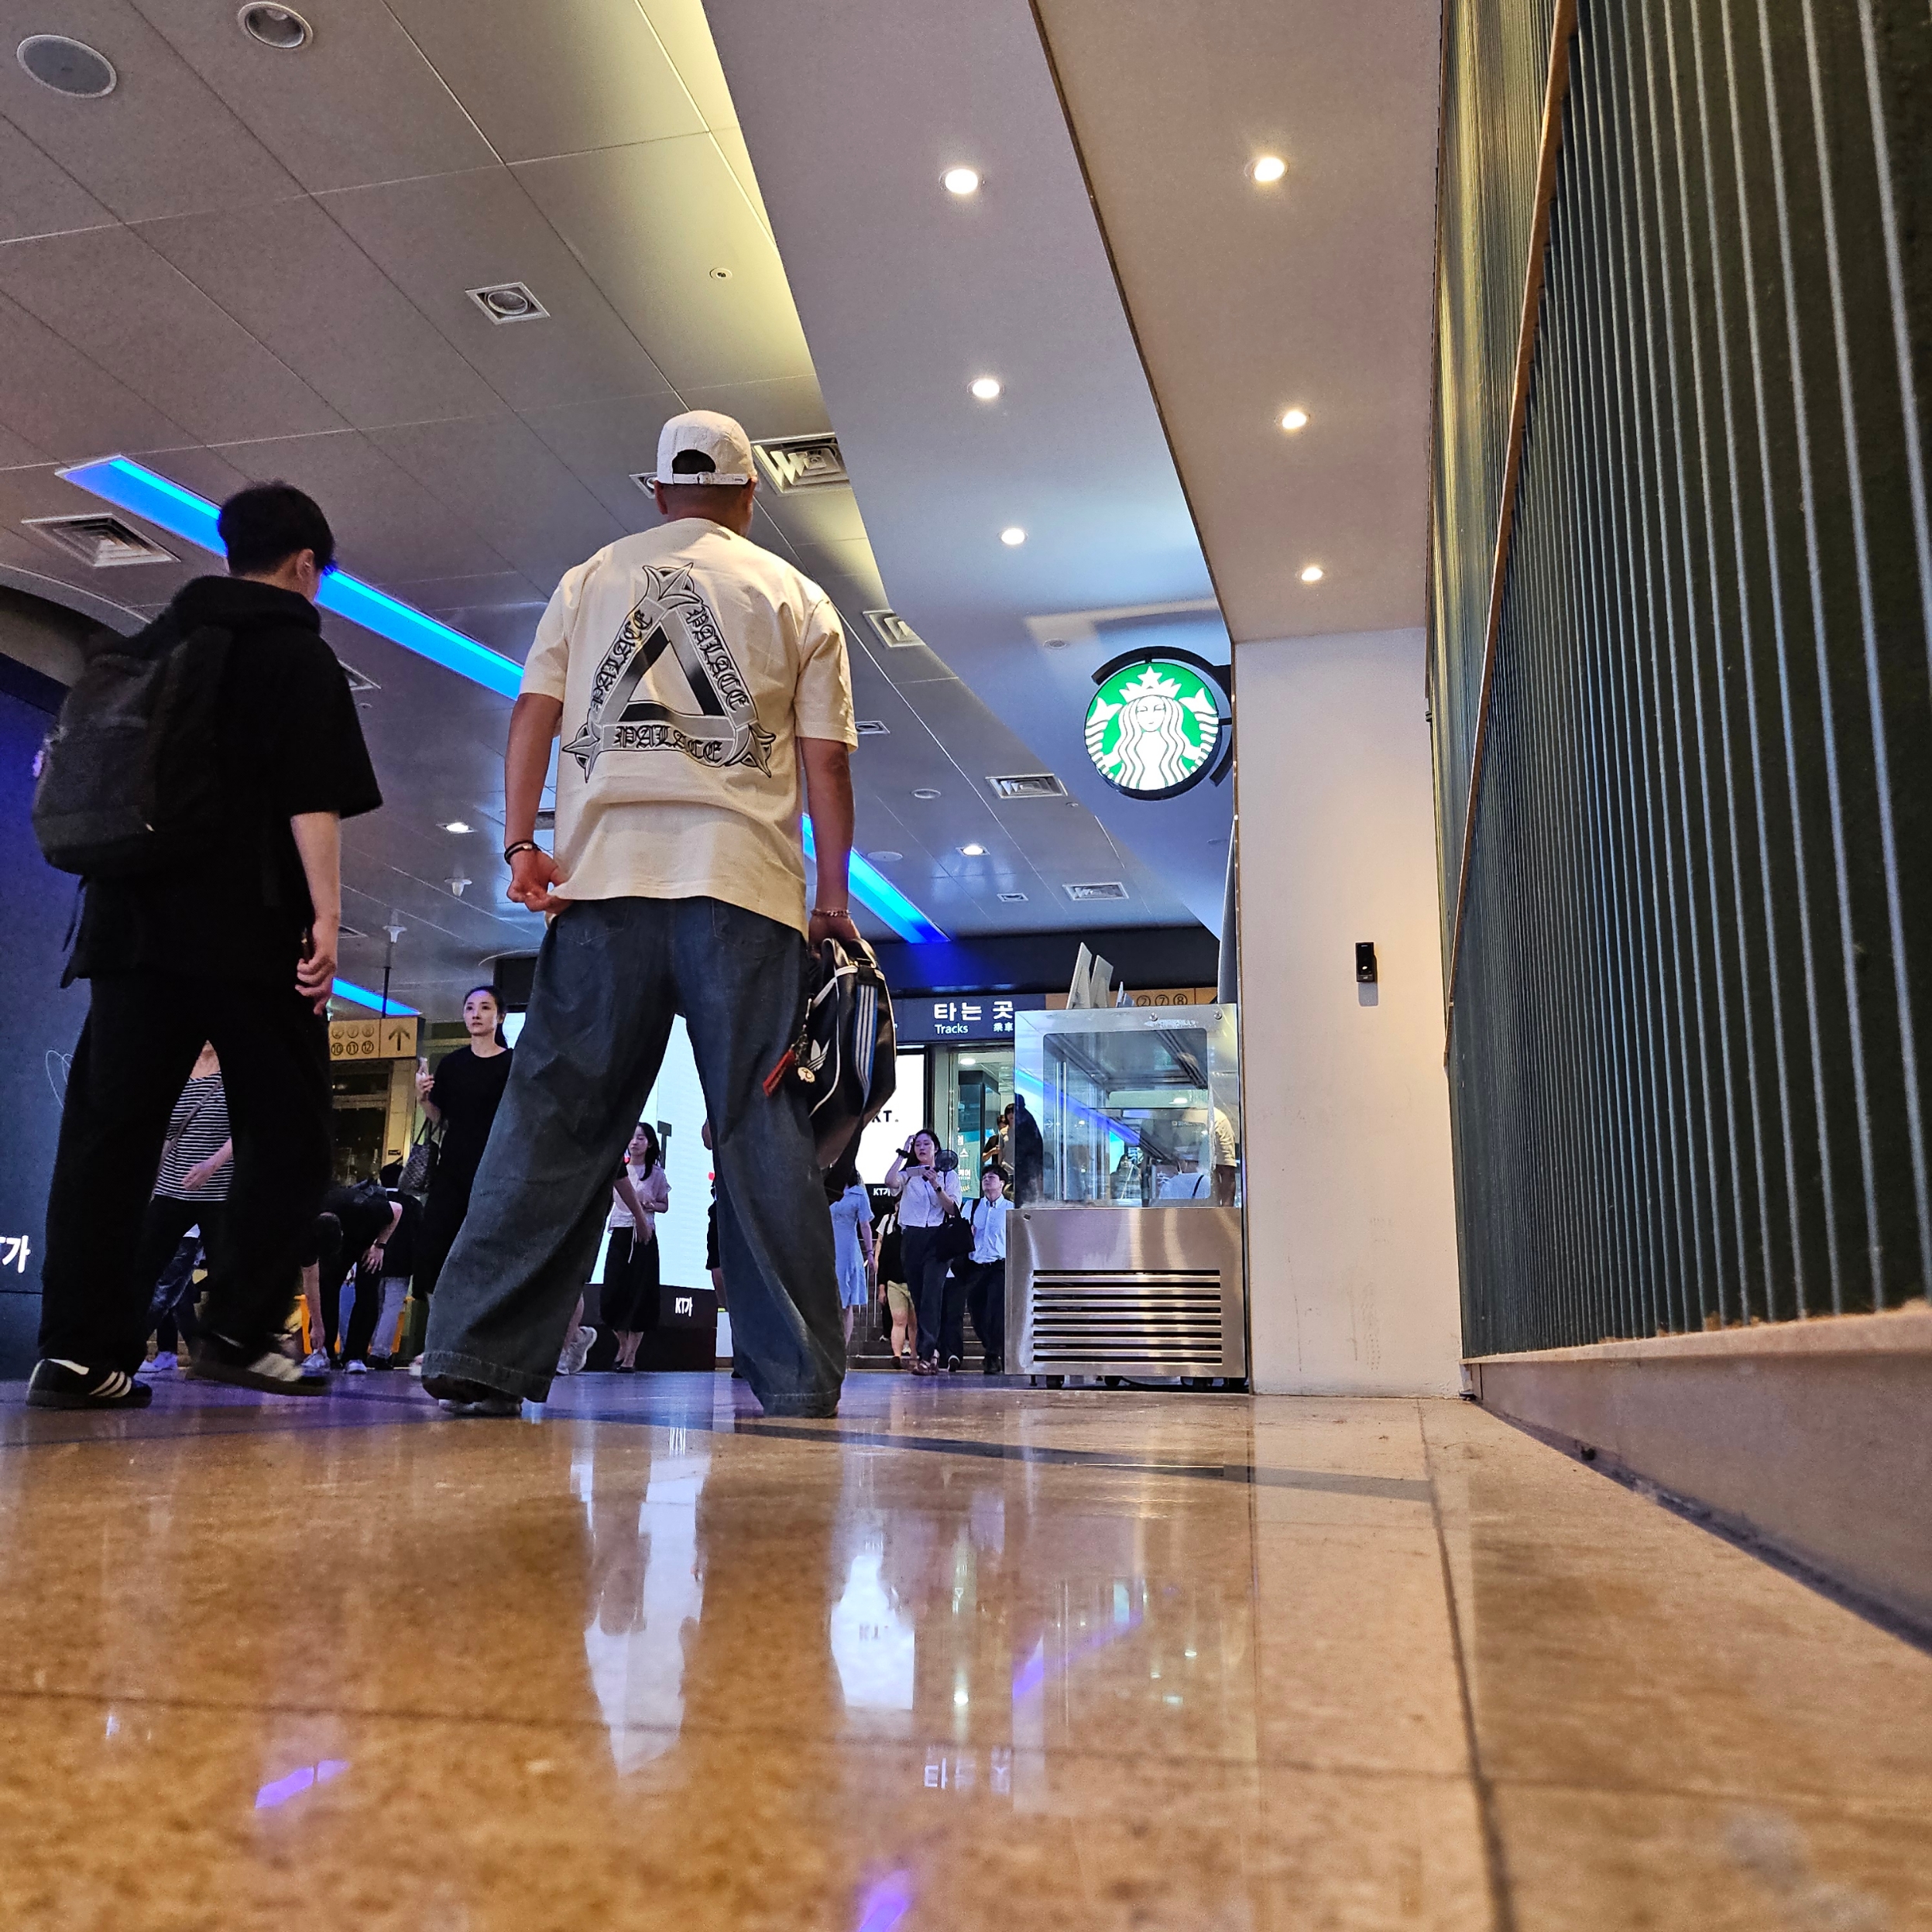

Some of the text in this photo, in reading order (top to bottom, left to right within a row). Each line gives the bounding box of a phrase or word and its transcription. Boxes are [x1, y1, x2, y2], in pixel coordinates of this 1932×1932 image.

[589, 609, 652, 712] PALACE
[685, 606, 749, 712] PALACE
[613, 724, 722, 763] PALACE
[934, 1000, 1014, 1021] 타는 곳
[934, 1022, 969, 1035] Tracks
